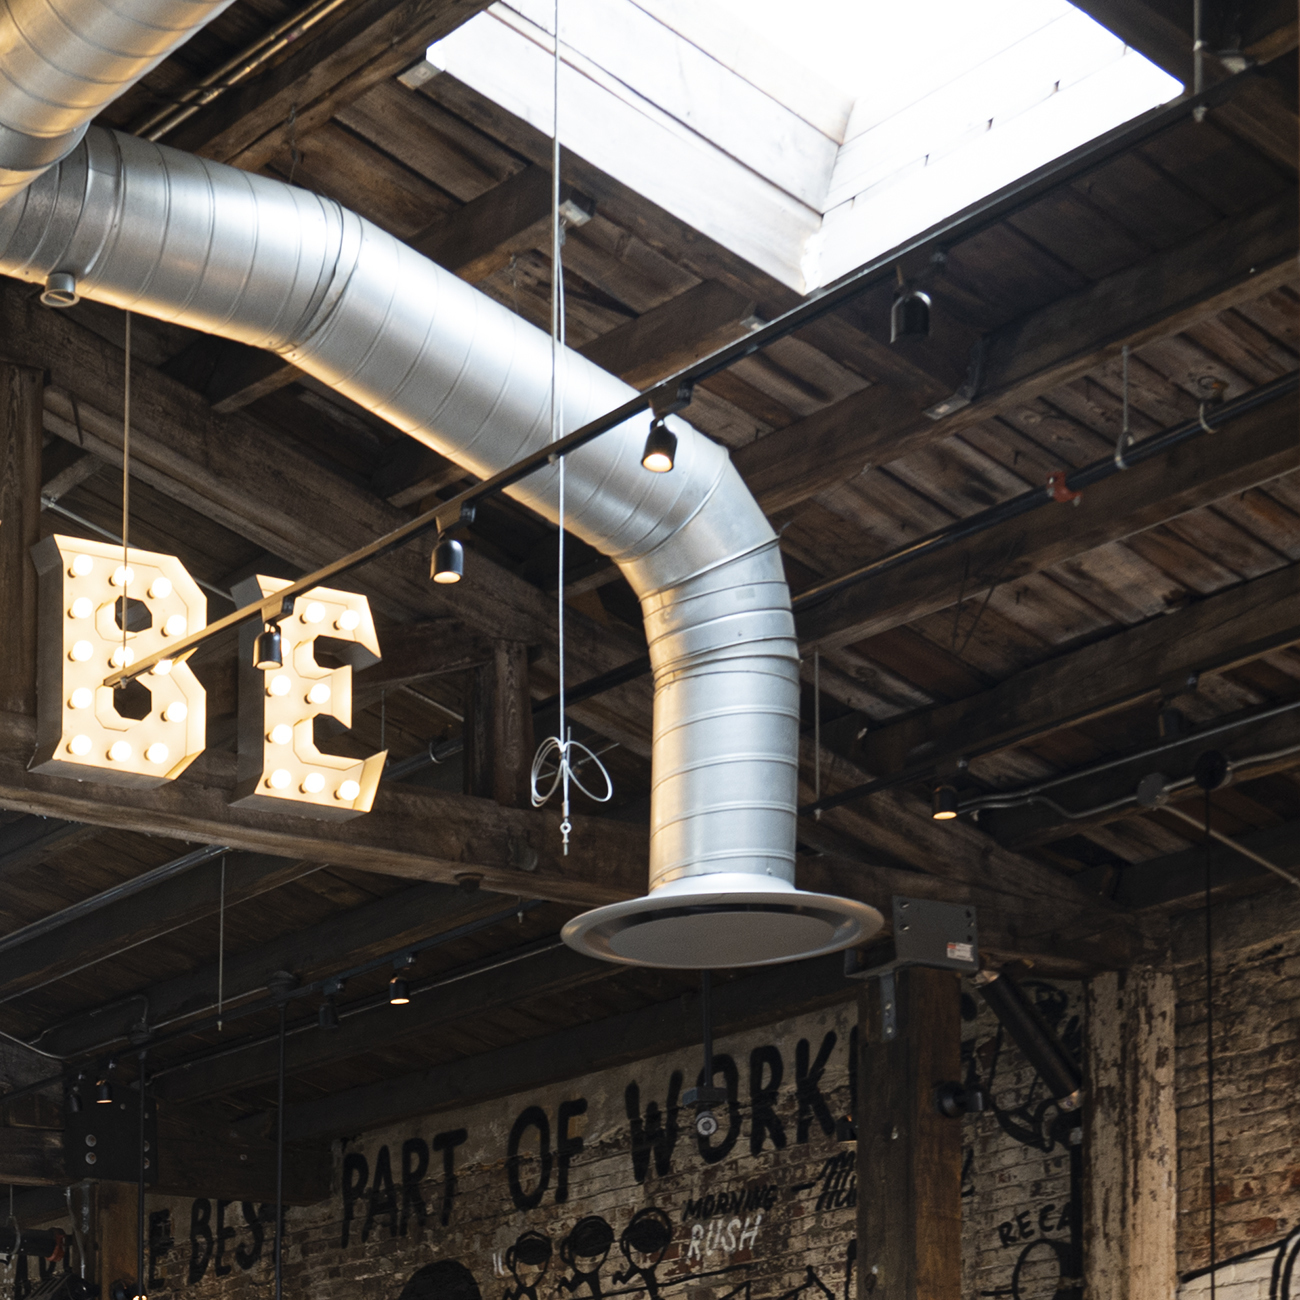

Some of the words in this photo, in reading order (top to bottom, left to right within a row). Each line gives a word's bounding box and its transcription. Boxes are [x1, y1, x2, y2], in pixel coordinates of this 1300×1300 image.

[341, 1128, 467, 1249] PART
[508, 1098, 588, 1210] OF
[625, 1027, 858, 1183] WORK
[681, 1185, 778, 1222] MORNING
[685, 1214, 763, 1264] RUSH
